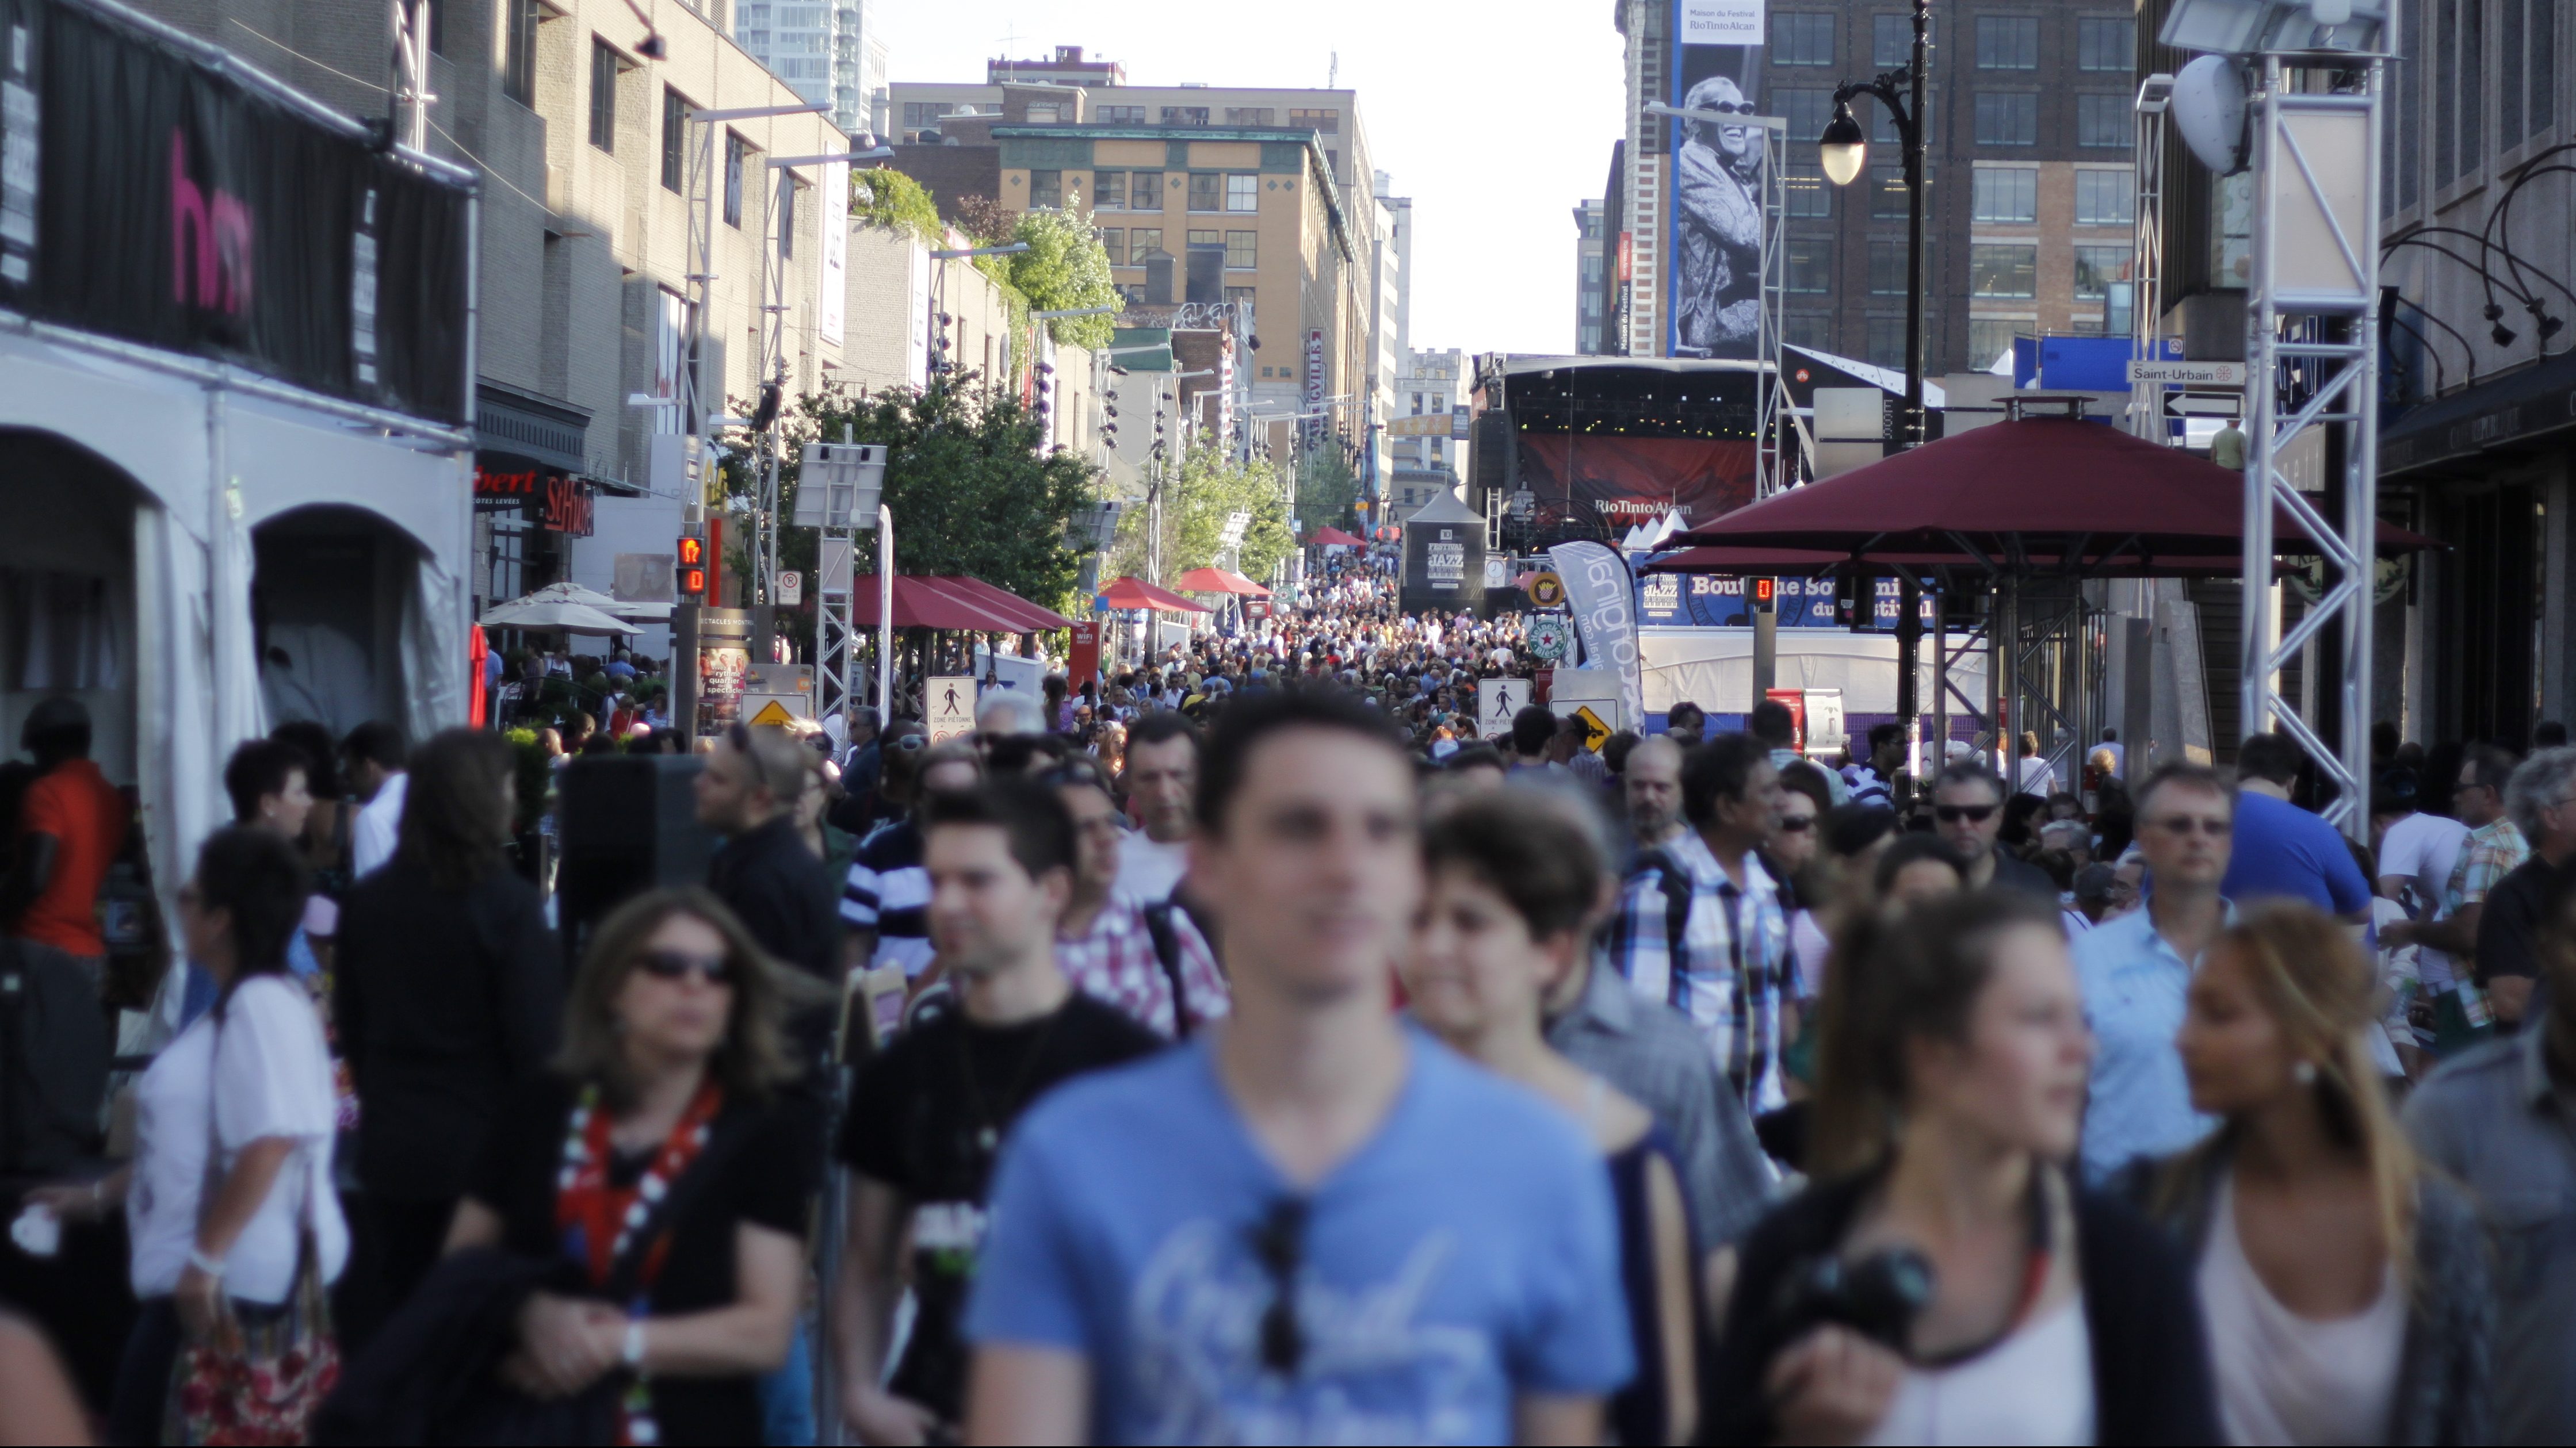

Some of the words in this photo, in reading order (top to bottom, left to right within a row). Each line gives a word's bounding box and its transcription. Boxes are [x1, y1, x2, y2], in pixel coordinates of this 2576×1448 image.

[1621, 313, 1628, 323] du
[2134, 367, 2213, 381] Saint-Urbain
[1428, 554, 1464, 567] JAZZ
[1644, 584, 1677, 597] JAZZ
[1530, 623, 1563, 642] Heineken
[1535, 646, 1561, 656] Bière
